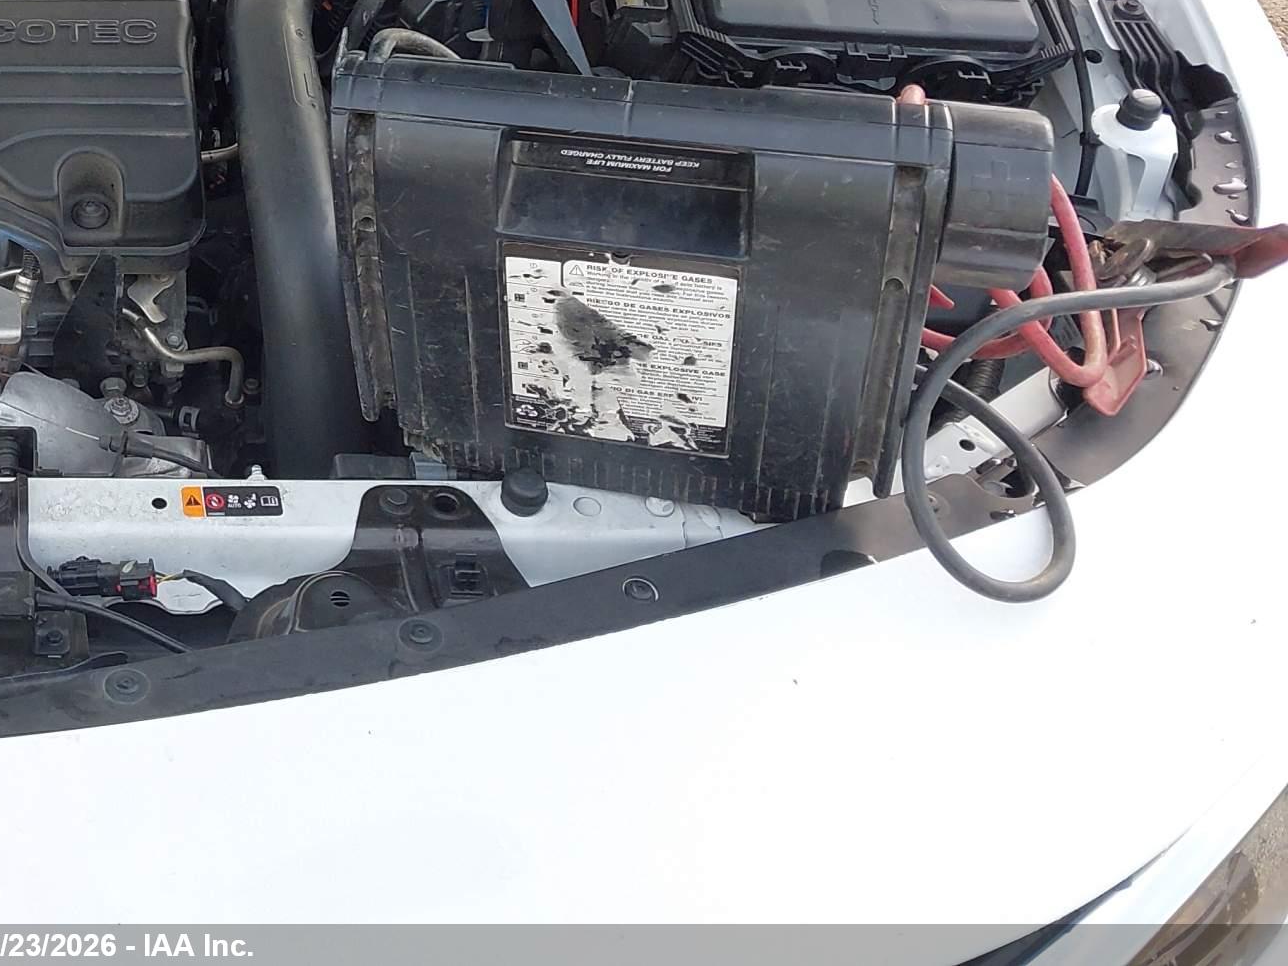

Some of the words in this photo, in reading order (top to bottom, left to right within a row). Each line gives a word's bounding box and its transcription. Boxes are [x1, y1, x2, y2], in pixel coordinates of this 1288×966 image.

[560, 149, 605, 159] CHARGED
[605, 153, 632, 162] FULLY
[586, 158, 607, 166] LIFE
[632, 155, 674, 165] BATTERY
[606, 161, 652, 171] MAXIMUM
[627, 269, 678, 280] EXPLOSIE
[682, 275, 713, 284] GASES
[639, 304, 670, 313] GASES
[673, 307, 731, 319] EXPLOSIVOS
[650, 363, 699, 374] EXPLOSIVE
